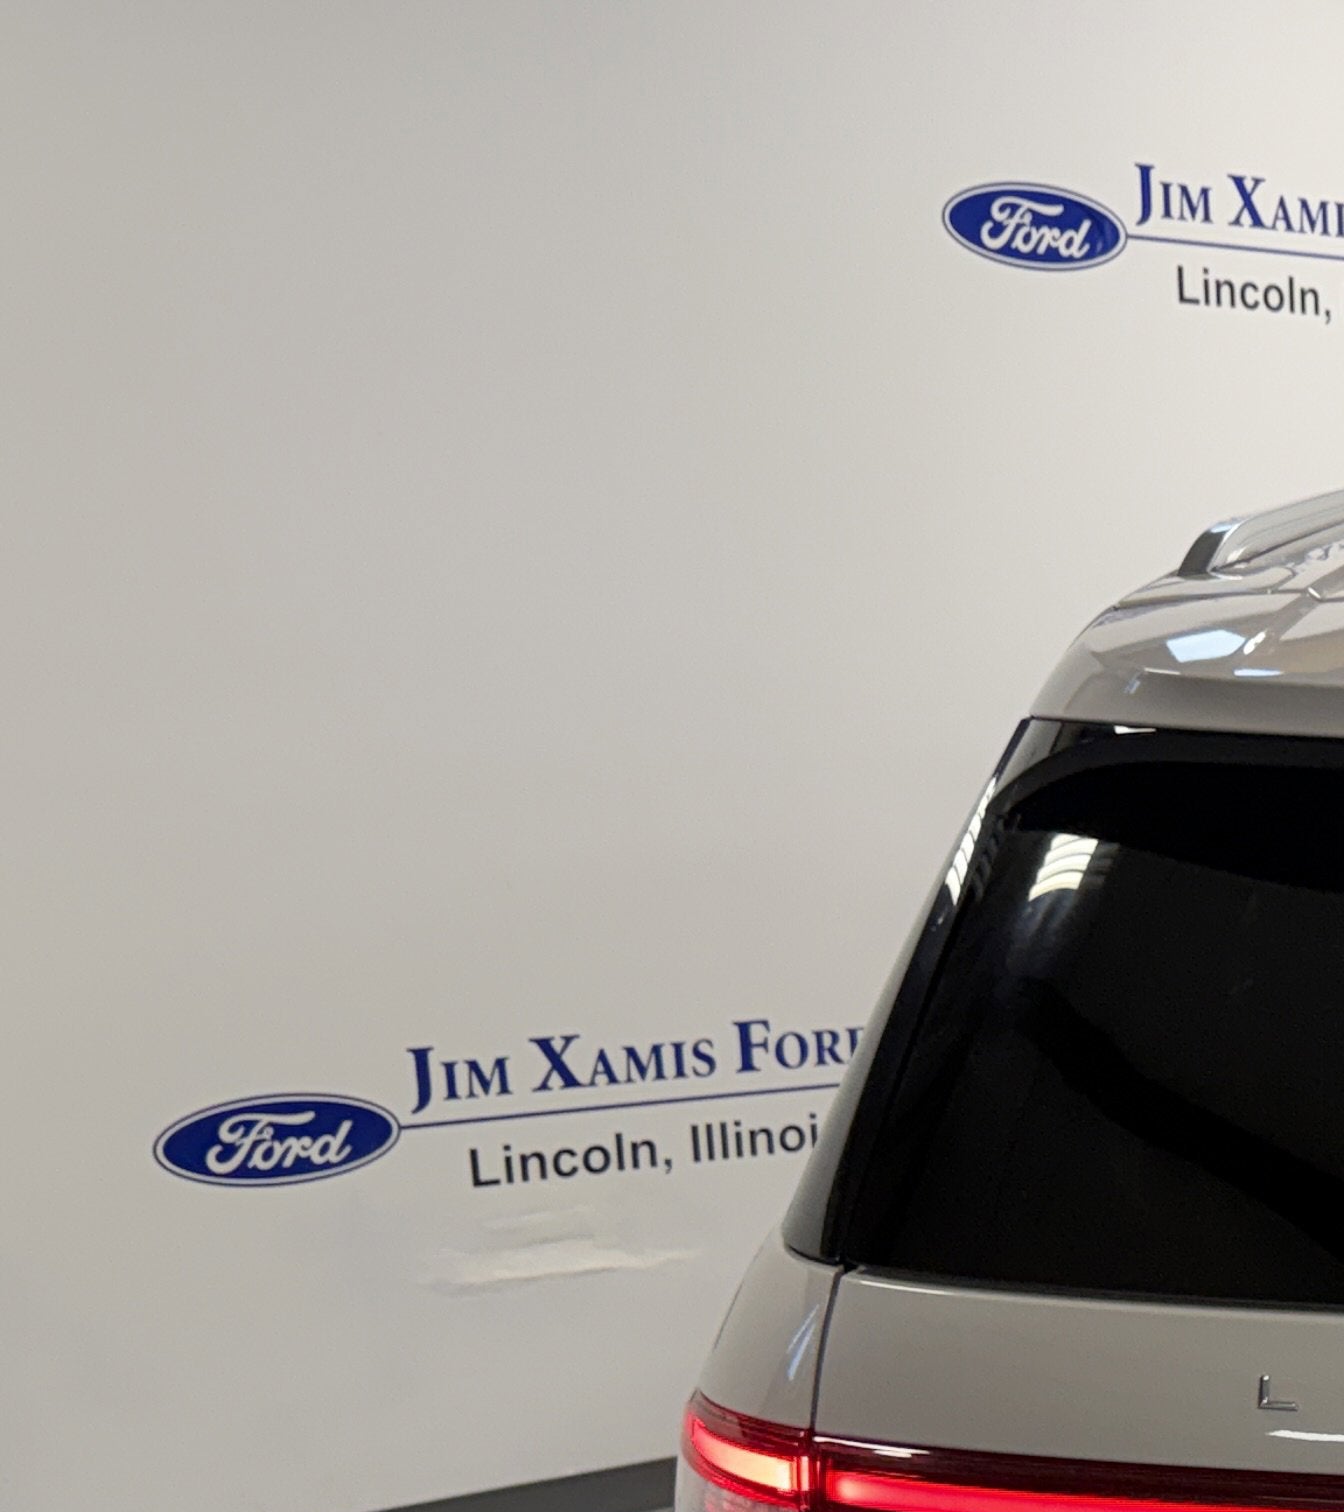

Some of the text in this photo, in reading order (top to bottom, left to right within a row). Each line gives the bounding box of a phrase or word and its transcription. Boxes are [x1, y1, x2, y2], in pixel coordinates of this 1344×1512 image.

[981, 196, 1090, 260] Ford
[1177, 265, 1331, 324] Lincoln,
[206, 1111, 354, 1175] Ford
[469, 1112, 817, 1188] Lincoln, Illinoi
